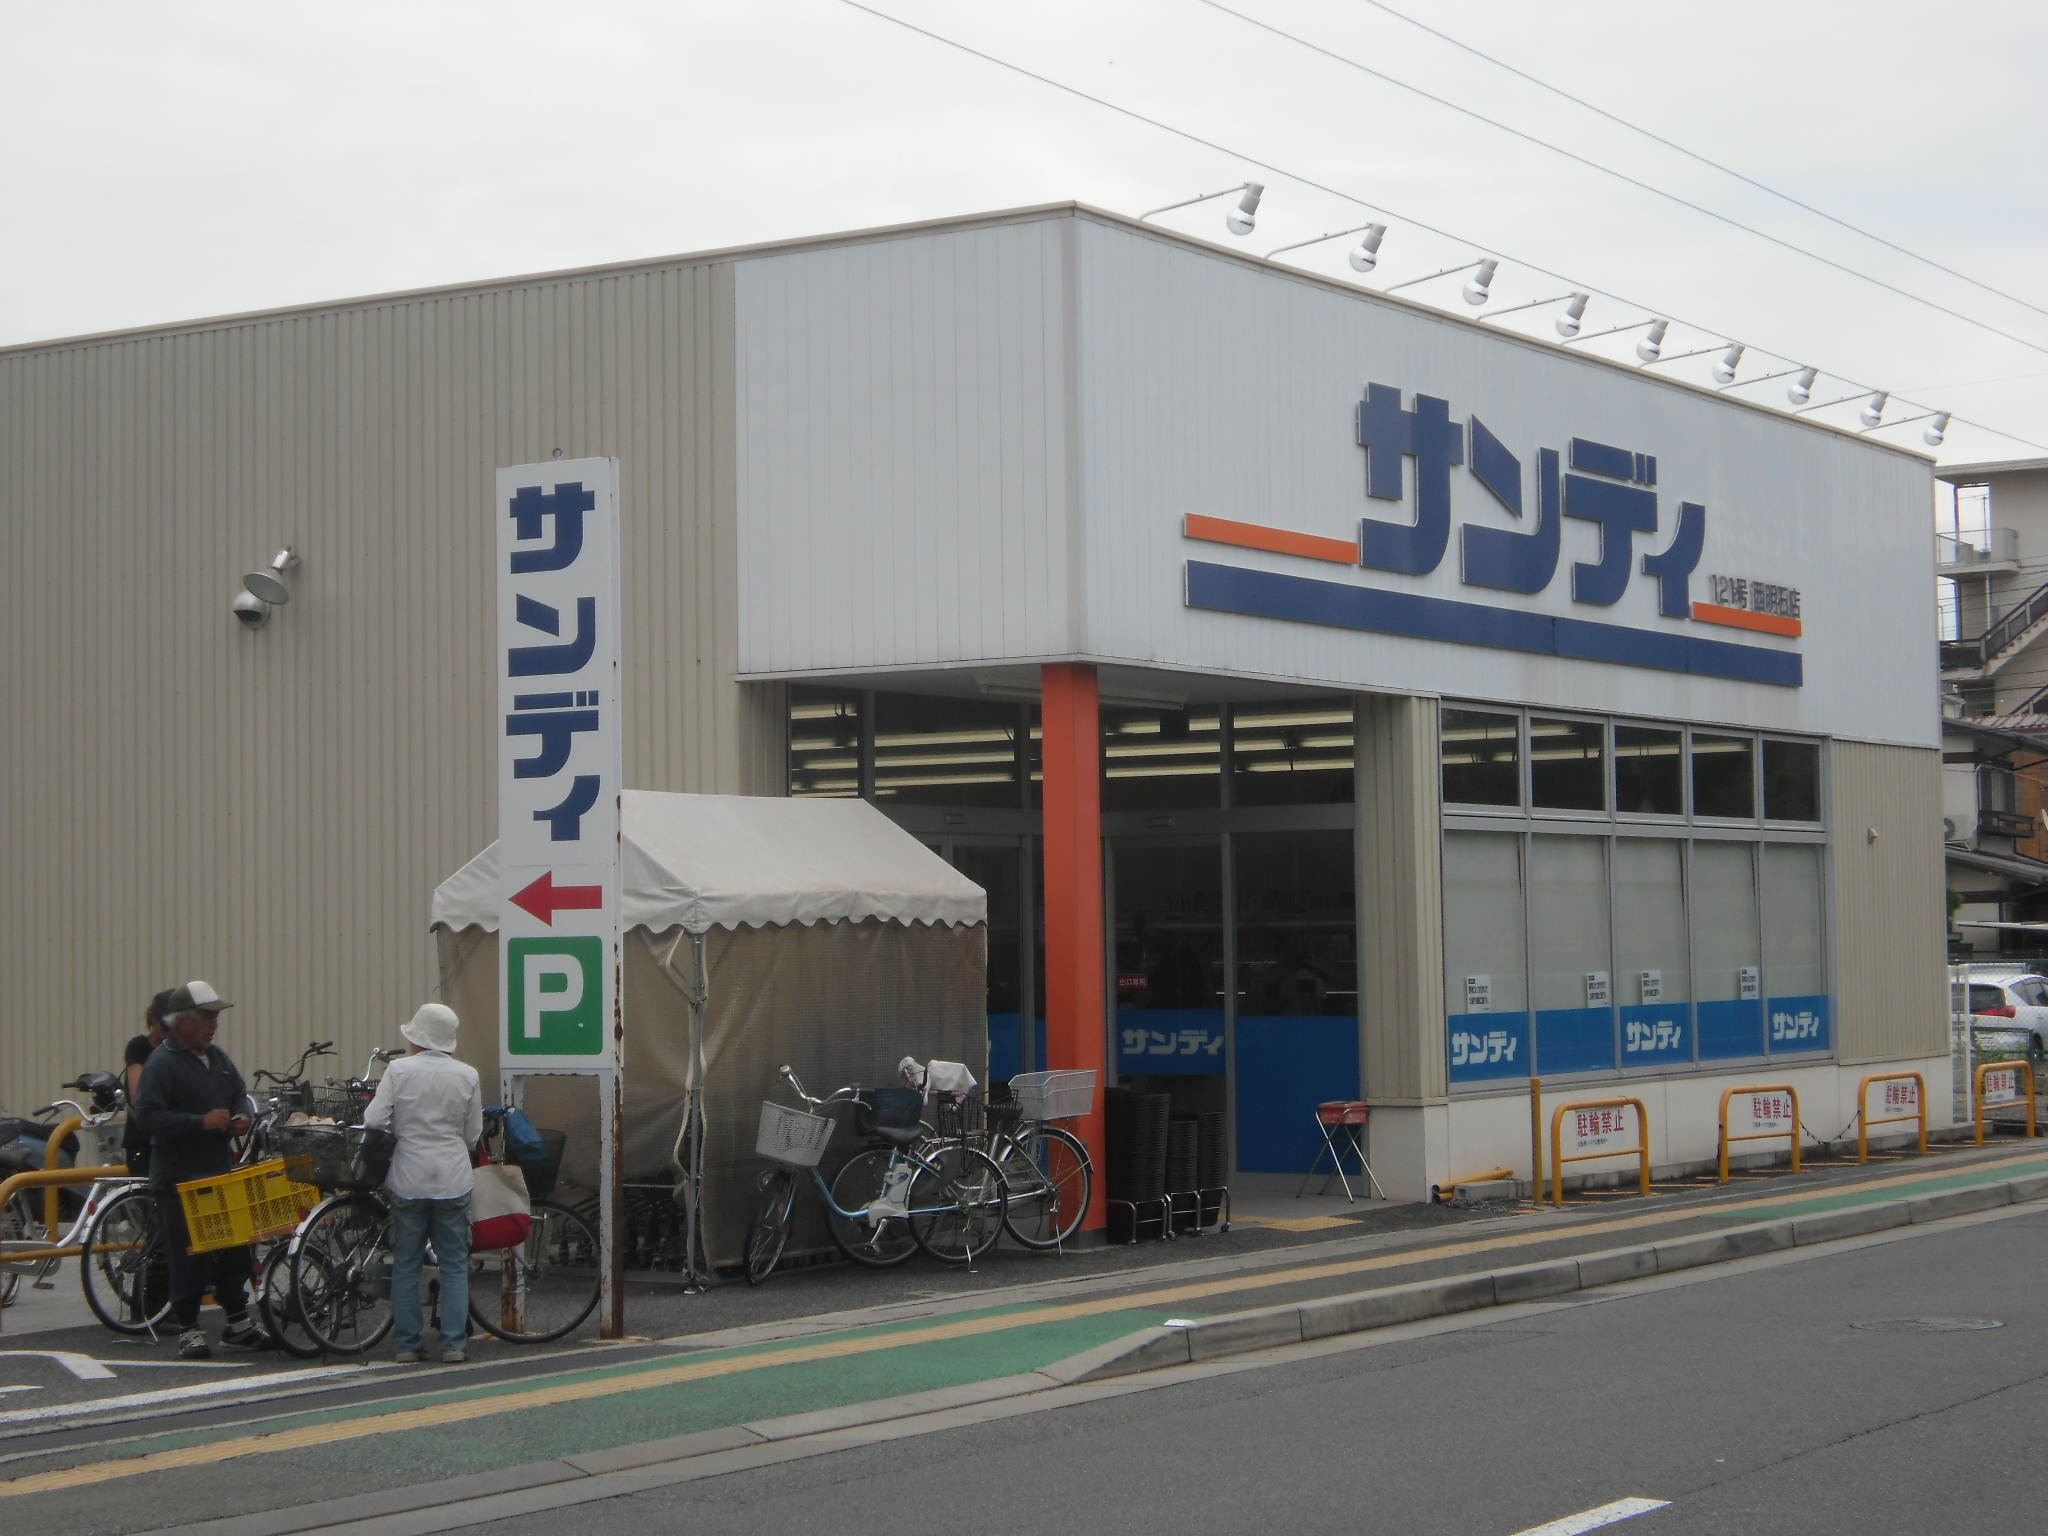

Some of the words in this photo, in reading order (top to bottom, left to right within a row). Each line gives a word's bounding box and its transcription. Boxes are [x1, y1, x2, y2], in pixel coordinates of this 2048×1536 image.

[1358, 381, 1706, 619] サンディ
[506, 481, 601, 842] サンディ
[522, 954, 585, 1038] P
[1626, 1020, 1682, 1052] サンディ
[1772, 1011, 1820, 1041] サンディ
[1122, 1029, 1224, 1056] サンディ
[1451, 1031, 1517, 1066] サンディ
[1577, 1109, 1625, 1138] 駐輪禁止
[1753, 1096, 1792, 1119] 駐輪禁止
